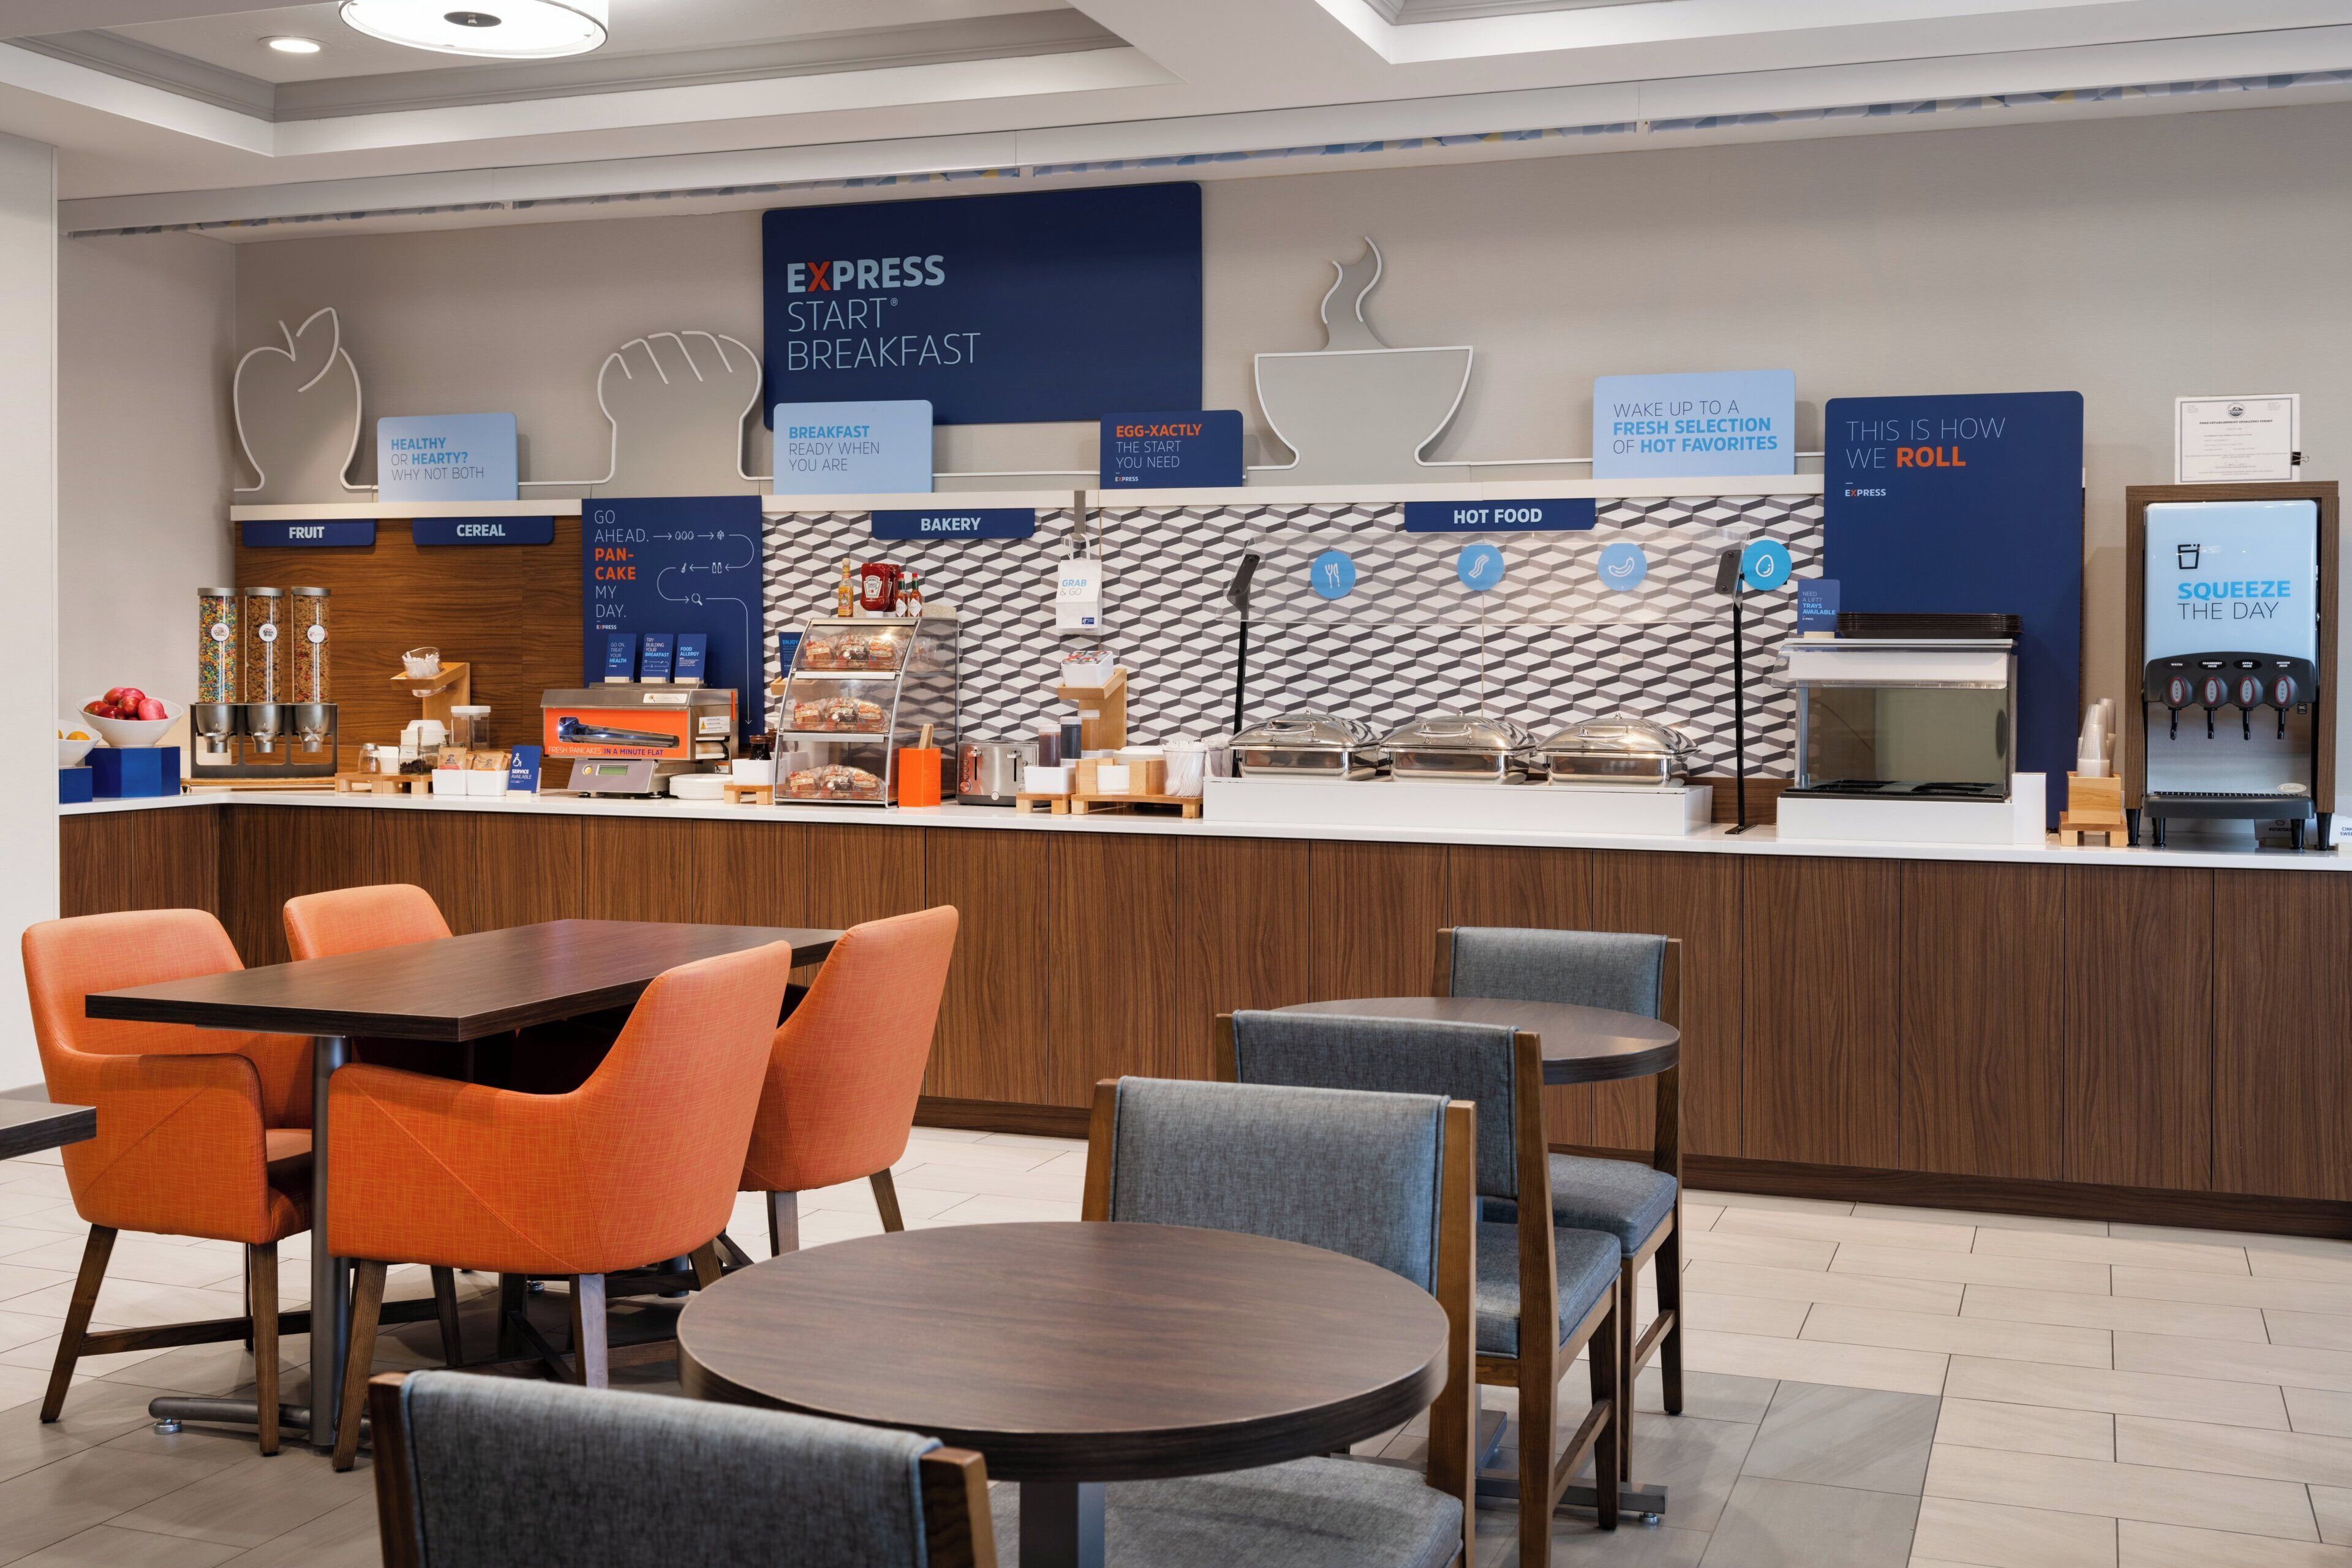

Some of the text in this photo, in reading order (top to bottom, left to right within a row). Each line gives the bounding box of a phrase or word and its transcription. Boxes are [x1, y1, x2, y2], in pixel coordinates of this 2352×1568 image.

[787, 254, 946, 293] EXPRESS
[788, 333, 981, 371] BREAKFAST
[1613, 399, 1740, 418] WAKE UP TO A
[789, 425, 870, 439] BREAKFAST
[1116, 423, 1202, 437] EGG-XACTLY
[1613, 417, 1771, 435] FRESH SELECTION
[1845, 417, 2006, 442] THIS IS HOW
[391, 437, 447, 450] HEALTHY
[789, 442, 880, 456] READY WHEN
[1116, 440, 1182, 453] THE START
[1613, 435, 1778, 454] OF HOT FAVORITES
[391, 451, 468, 466] OR HEARTY?
[1116, 456, 1180, 469] YOU NEED
[1845, 446, 1967, 469] WE ROLL
[789, 458, 848, 472] YOU ARE
[391, 467, 484, 481] WHY NOT BOTH
[1844, 488, 1887, 497] EXPRESS
[594, 510, 616, 524] GO
[1453, 508, 1543, 524] HOT FOOD
[456, 524, 506, 537] CEREAL
[921, 518, 981, 531] BAKERY
[288, 526, 325, 539] FRUIT
[594, 529, 649, 543] AHEAD.
[595, 548, 634, 562] PAN-
[595, 566, 636, 580] CAKE
[595, 585, 617, 599] MY
[2177, 581, 2291, 601] SQUEEZE
[596, 604, 627, 618] DAY.
[2177, 601, 2279, 620] THE DAY
